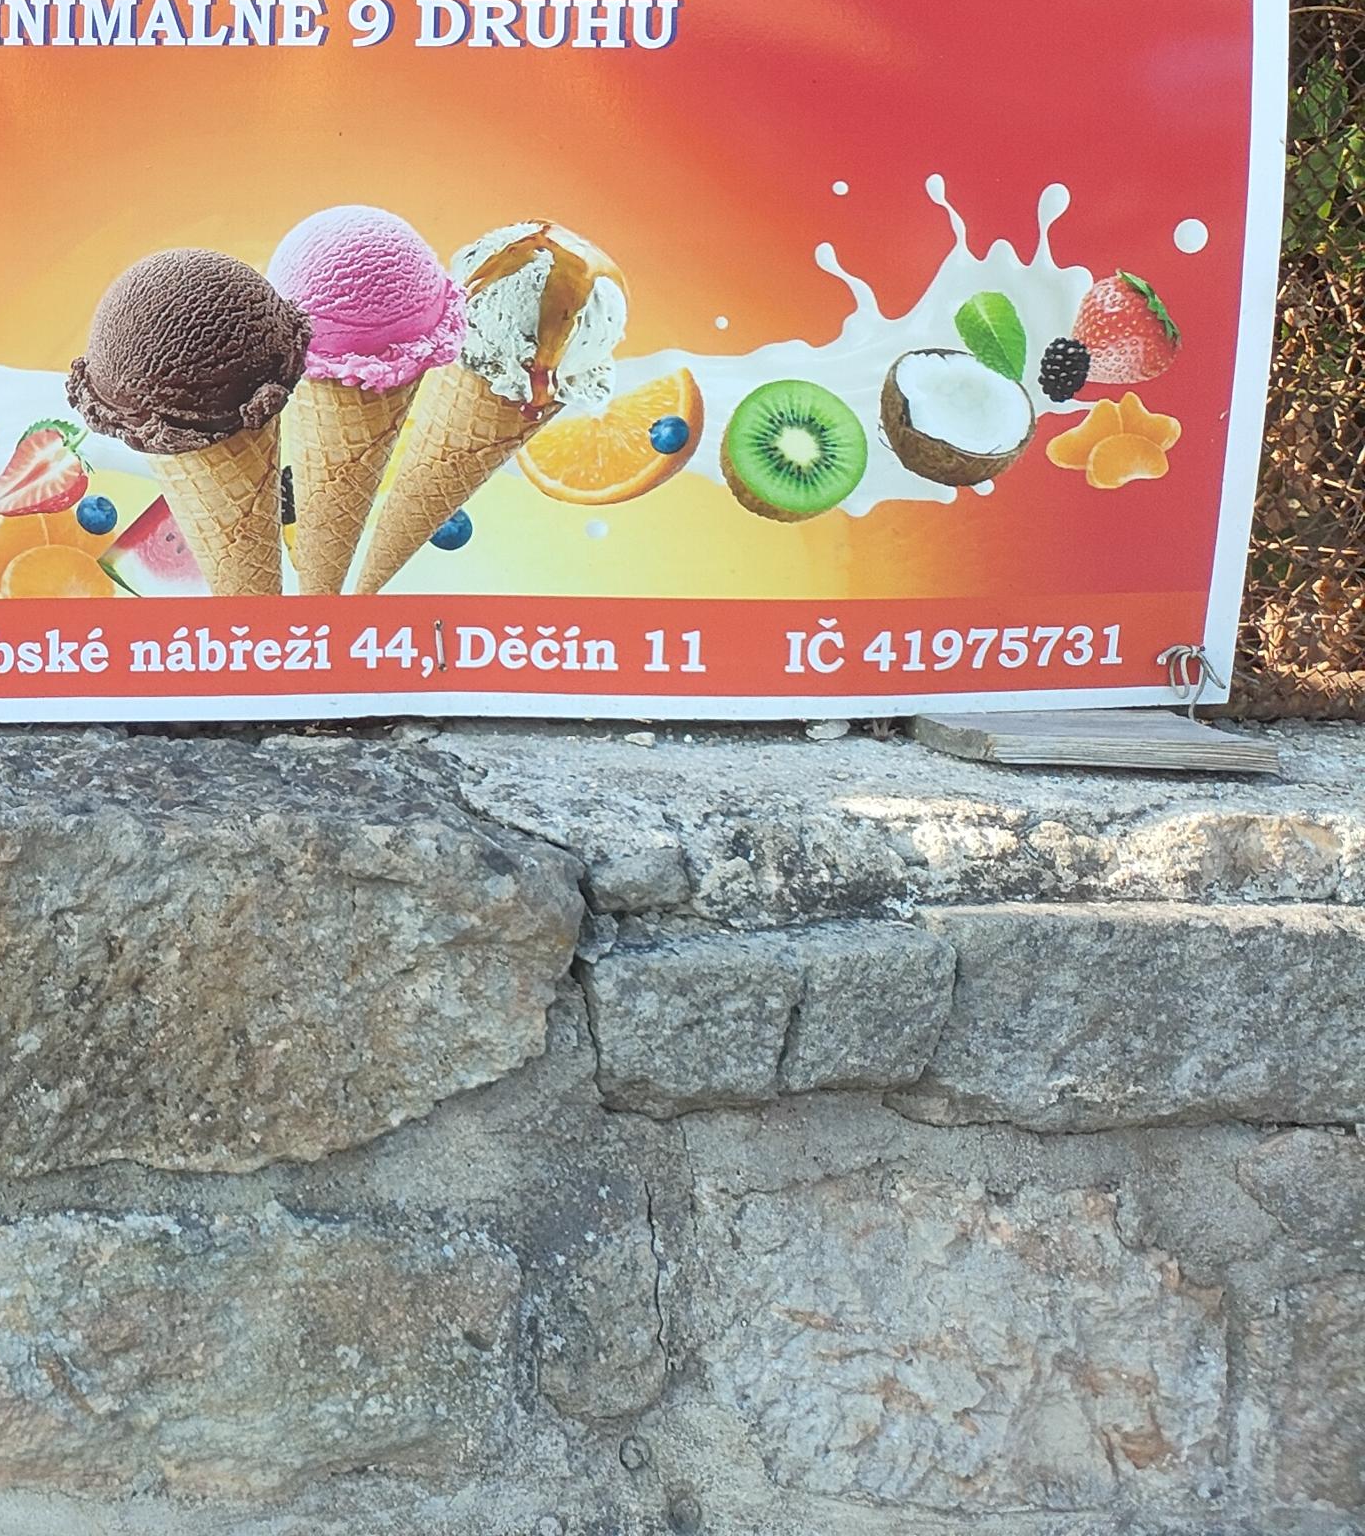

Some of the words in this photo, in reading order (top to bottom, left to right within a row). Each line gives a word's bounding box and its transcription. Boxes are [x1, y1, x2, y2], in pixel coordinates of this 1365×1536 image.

[130, 625, 331, 673] nábřeží
[349, 627, 435, 679] 44,
[455, 625, 619, 672] Děčín
[644, 630, 706, 673] 11
[785, 619, 846, 673] IČ
[863, 624, 1124, 672] 41975731
